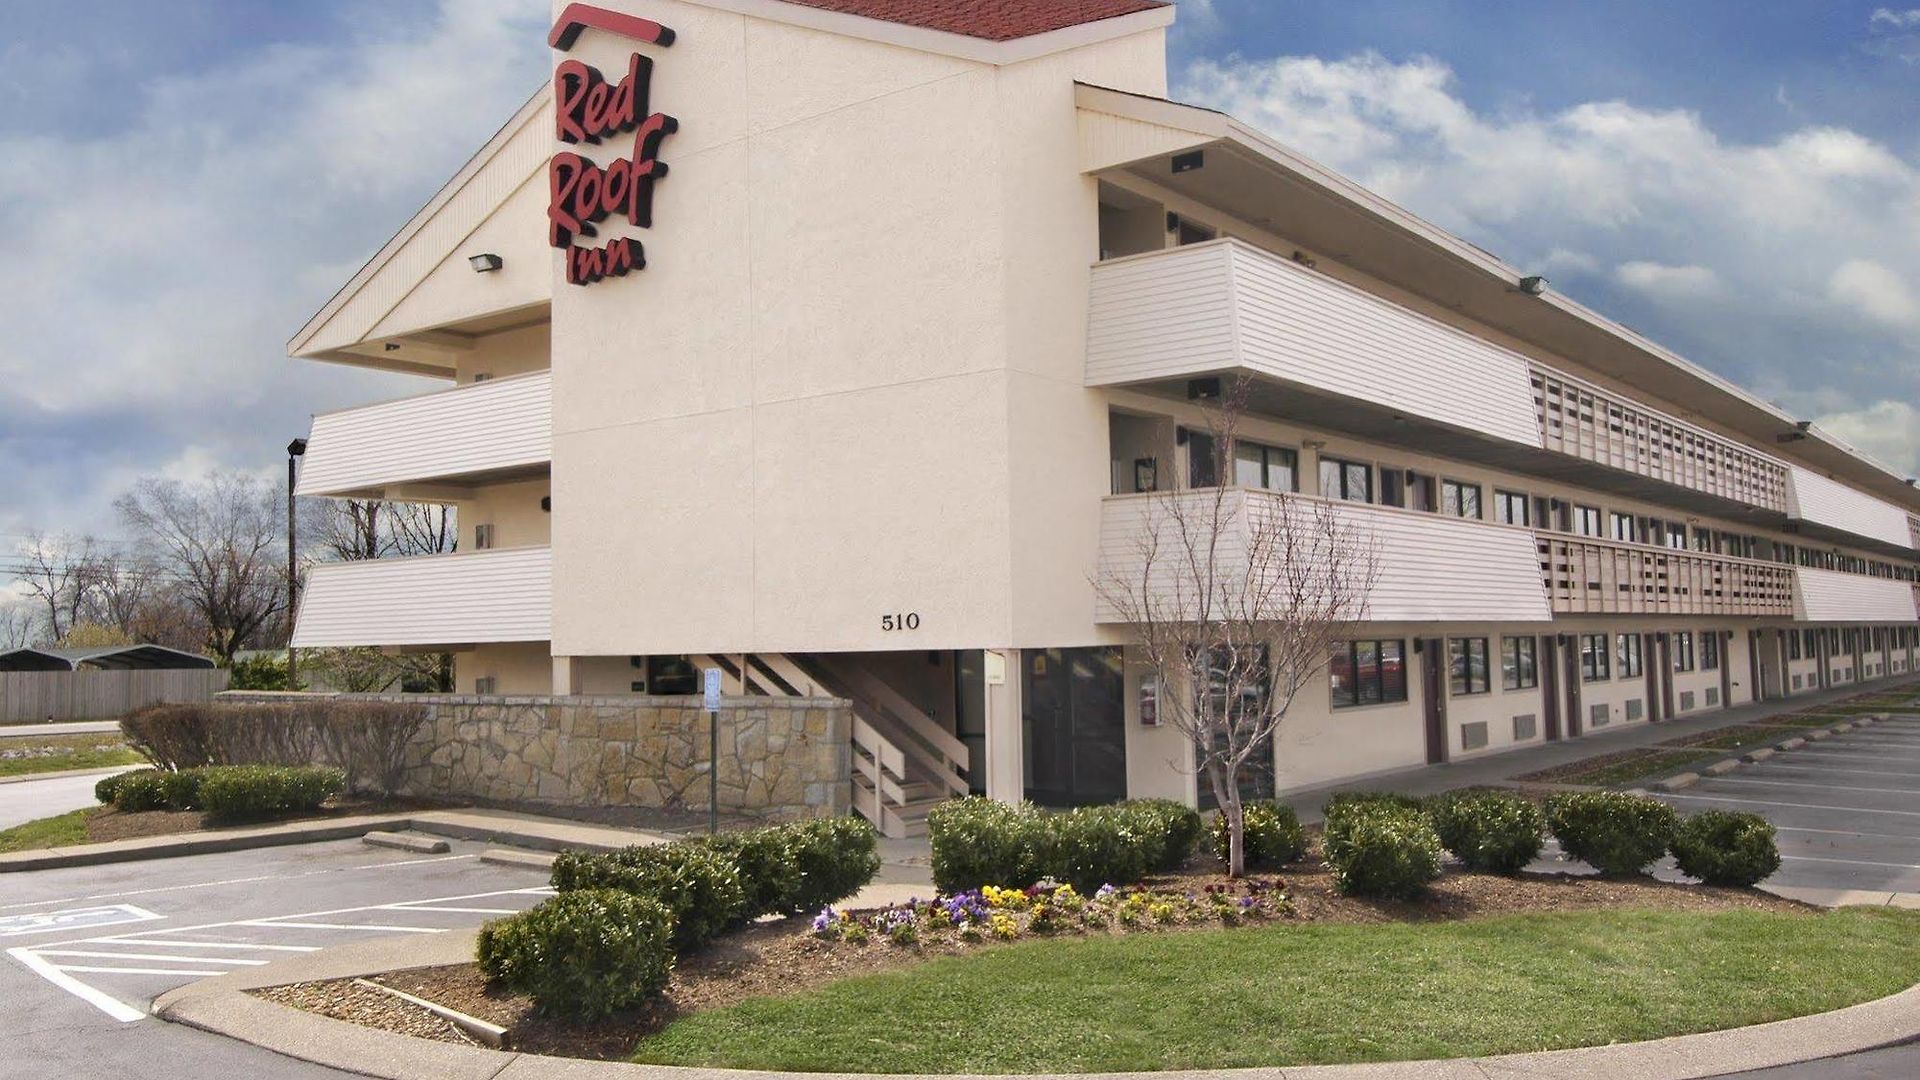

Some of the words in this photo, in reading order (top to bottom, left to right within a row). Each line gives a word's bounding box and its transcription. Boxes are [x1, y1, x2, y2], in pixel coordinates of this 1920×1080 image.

[555, 52, 651, 143] Red
[548, 113, 674, 247] Roof
[882, 612, 920, 631] 510
